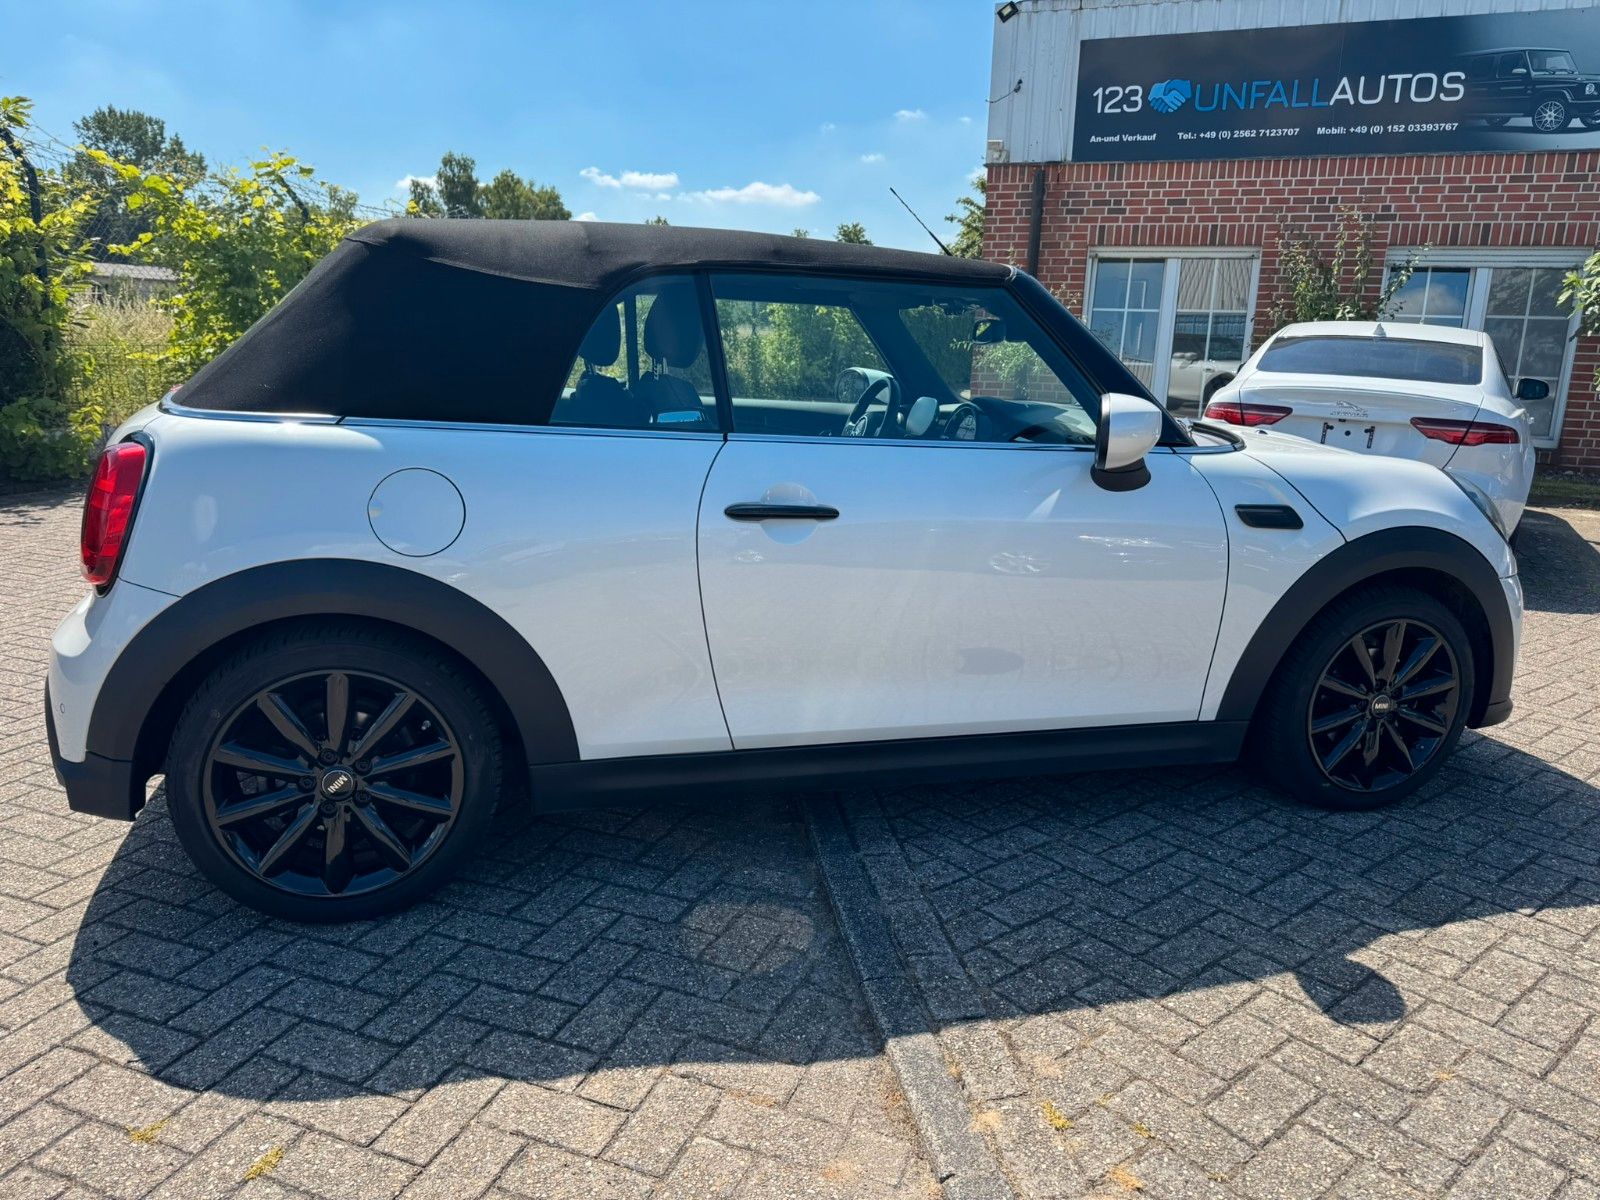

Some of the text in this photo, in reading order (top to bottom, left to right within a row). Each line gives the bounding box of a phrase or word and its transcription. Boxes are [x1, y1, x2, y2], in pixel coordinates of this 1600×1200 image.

[1092, 85, 1143, 114] 123
[1089, 122, 1459, 143] An-und Verkauf Tel.: +49 (0) 2562 7123707 Mobil: +49 (0) 152 03393767
[327, 774, 348, 794] MINI
